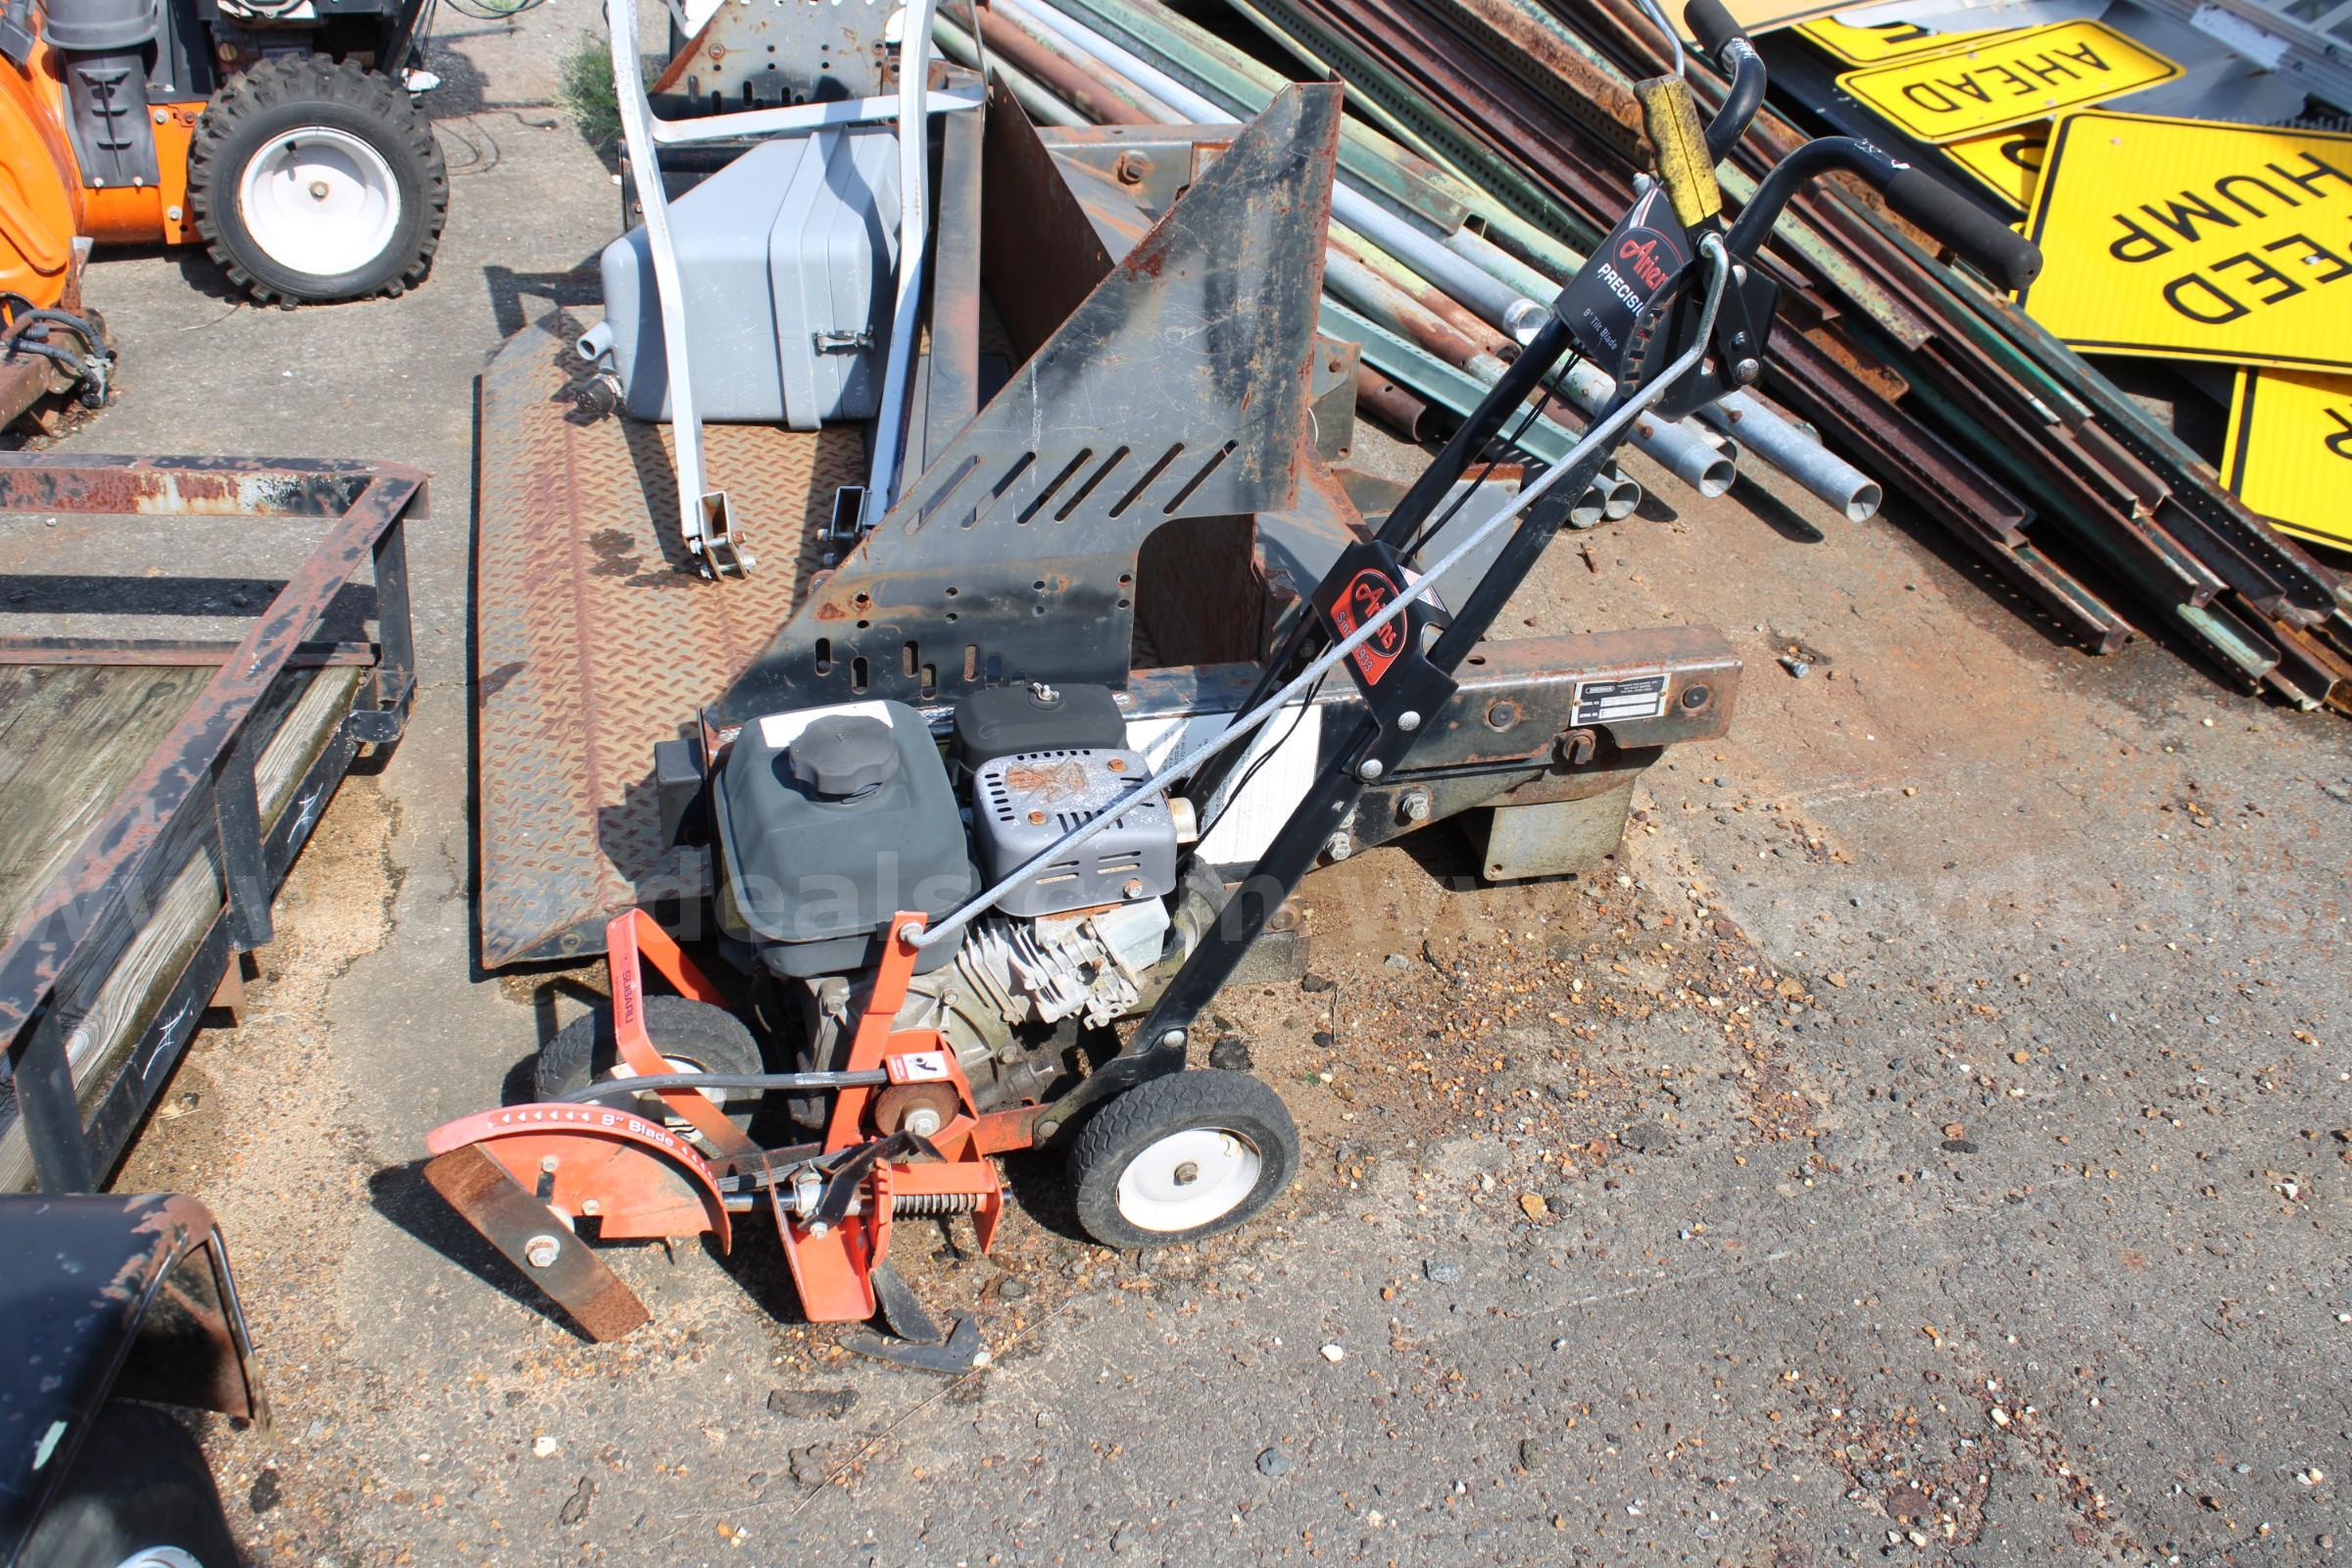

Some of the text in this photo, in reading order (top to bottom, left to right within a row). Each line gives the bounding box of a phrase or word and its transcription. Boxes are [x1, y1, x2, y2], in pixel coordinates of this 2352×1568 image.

[1902, 42, 2112, 113] AHEAD
[2109, 151, 2352, 264] HUMP
[1596, 263, 1645, 318] PRECISI
[2163, 214, 2352, 325] EED
[1599, 325, 1618, 351] Blade
[1337, 612, 1374, 672] Sinc 1933
[622, 970, 634, 1024] SUBARU
[628, 1119, 674, 1147] Blade
